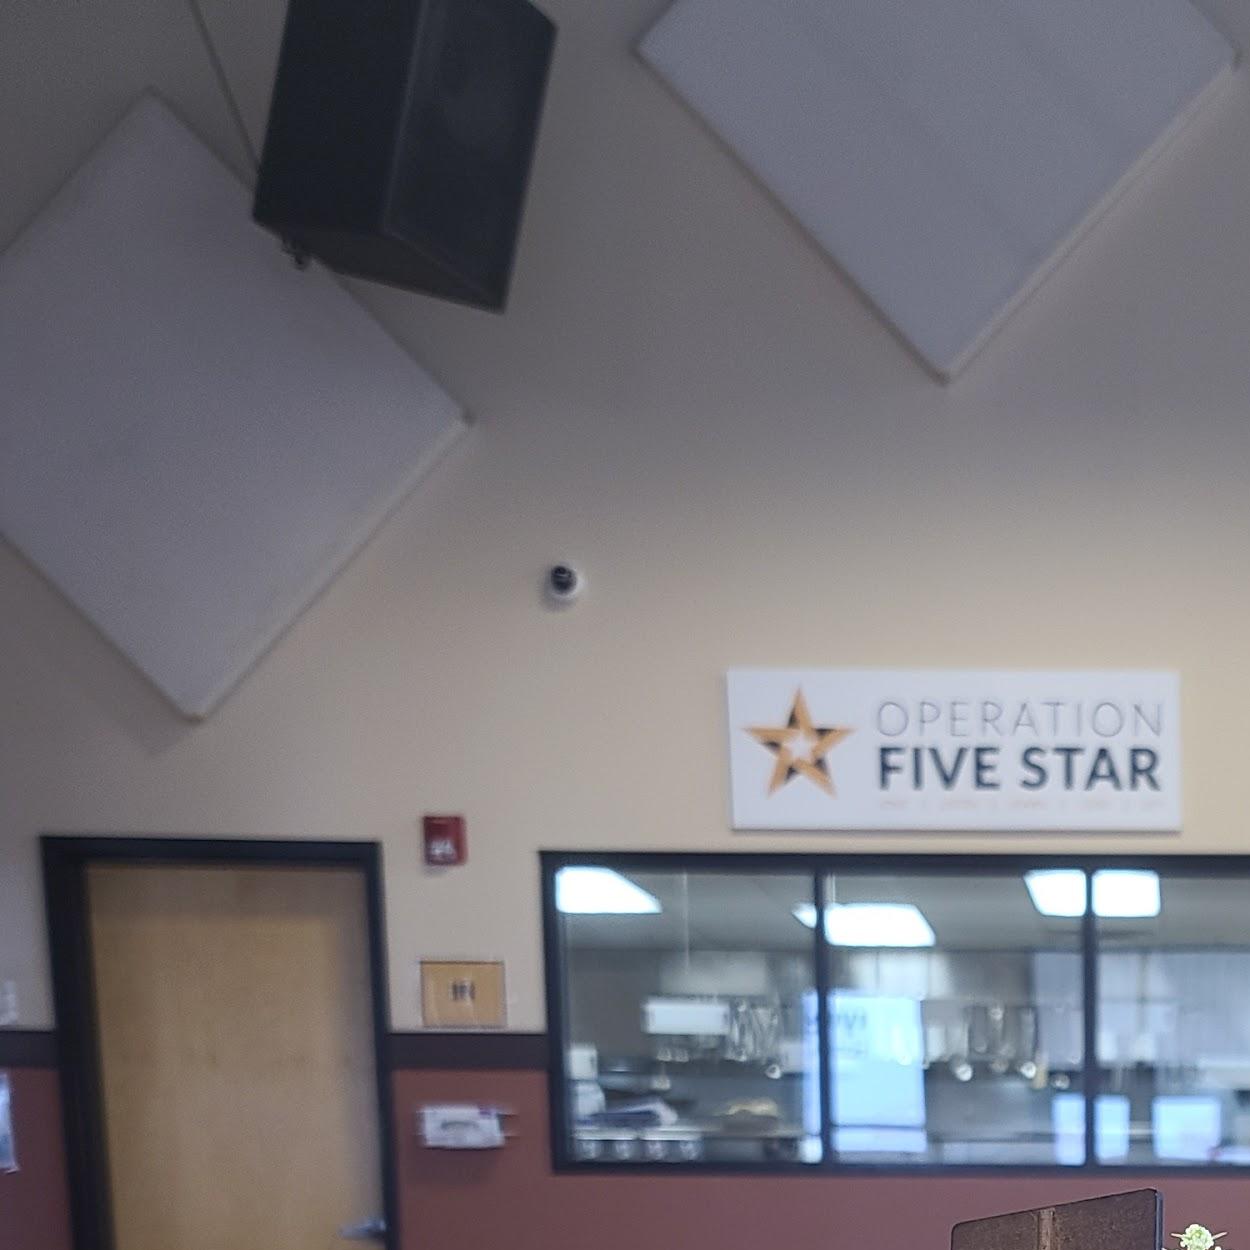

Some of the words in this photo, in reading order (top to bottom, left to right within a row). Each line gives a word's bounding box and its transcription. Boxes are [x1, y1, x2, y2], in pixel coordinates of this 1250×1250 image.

[878, 700, 1161, 737] OPERATION
[878, 746, 1001, 791] FIVE
[1018, 746, 1161, 791] STAR
